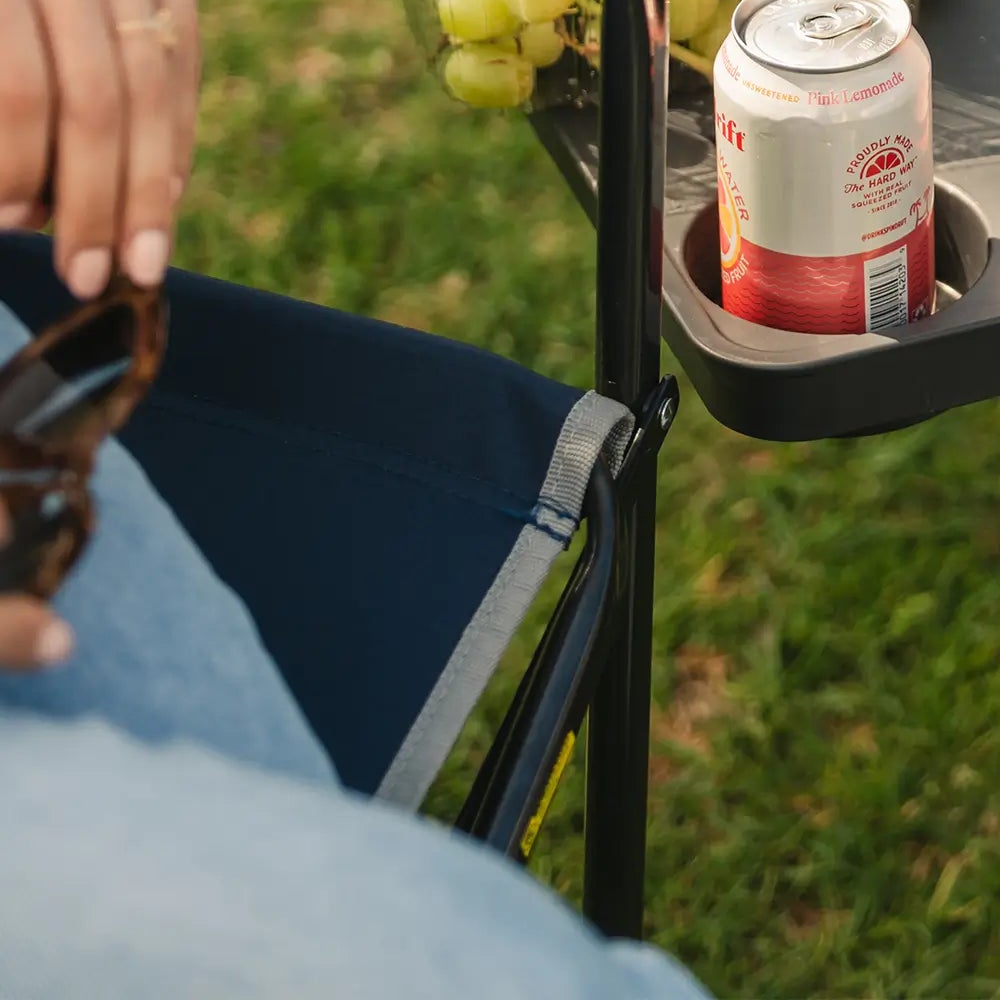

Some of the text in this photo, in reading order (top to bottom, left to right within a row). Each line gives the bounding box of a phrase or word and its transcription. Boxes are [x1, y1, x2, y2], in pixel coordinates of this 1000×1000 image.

[742, 80, 800, 103] UNSWEETENED
[807, 90, 840, 106] Pink
[842, 71, 905, 105] Lemonade
[716, 111, 746, 152] rift
[846, 134, 914, 174] PROUDLY MADE
[844, 183, 865, 194] The
[869, 171, 897, 188] HARD
[851, 180, 912, 209] SQUEEZED FRUIT
[863, 180, 903, 199] WITH REAL
[871, 203, 886, 214] SINCE
[730, 253, 750, 284] FRUIT
